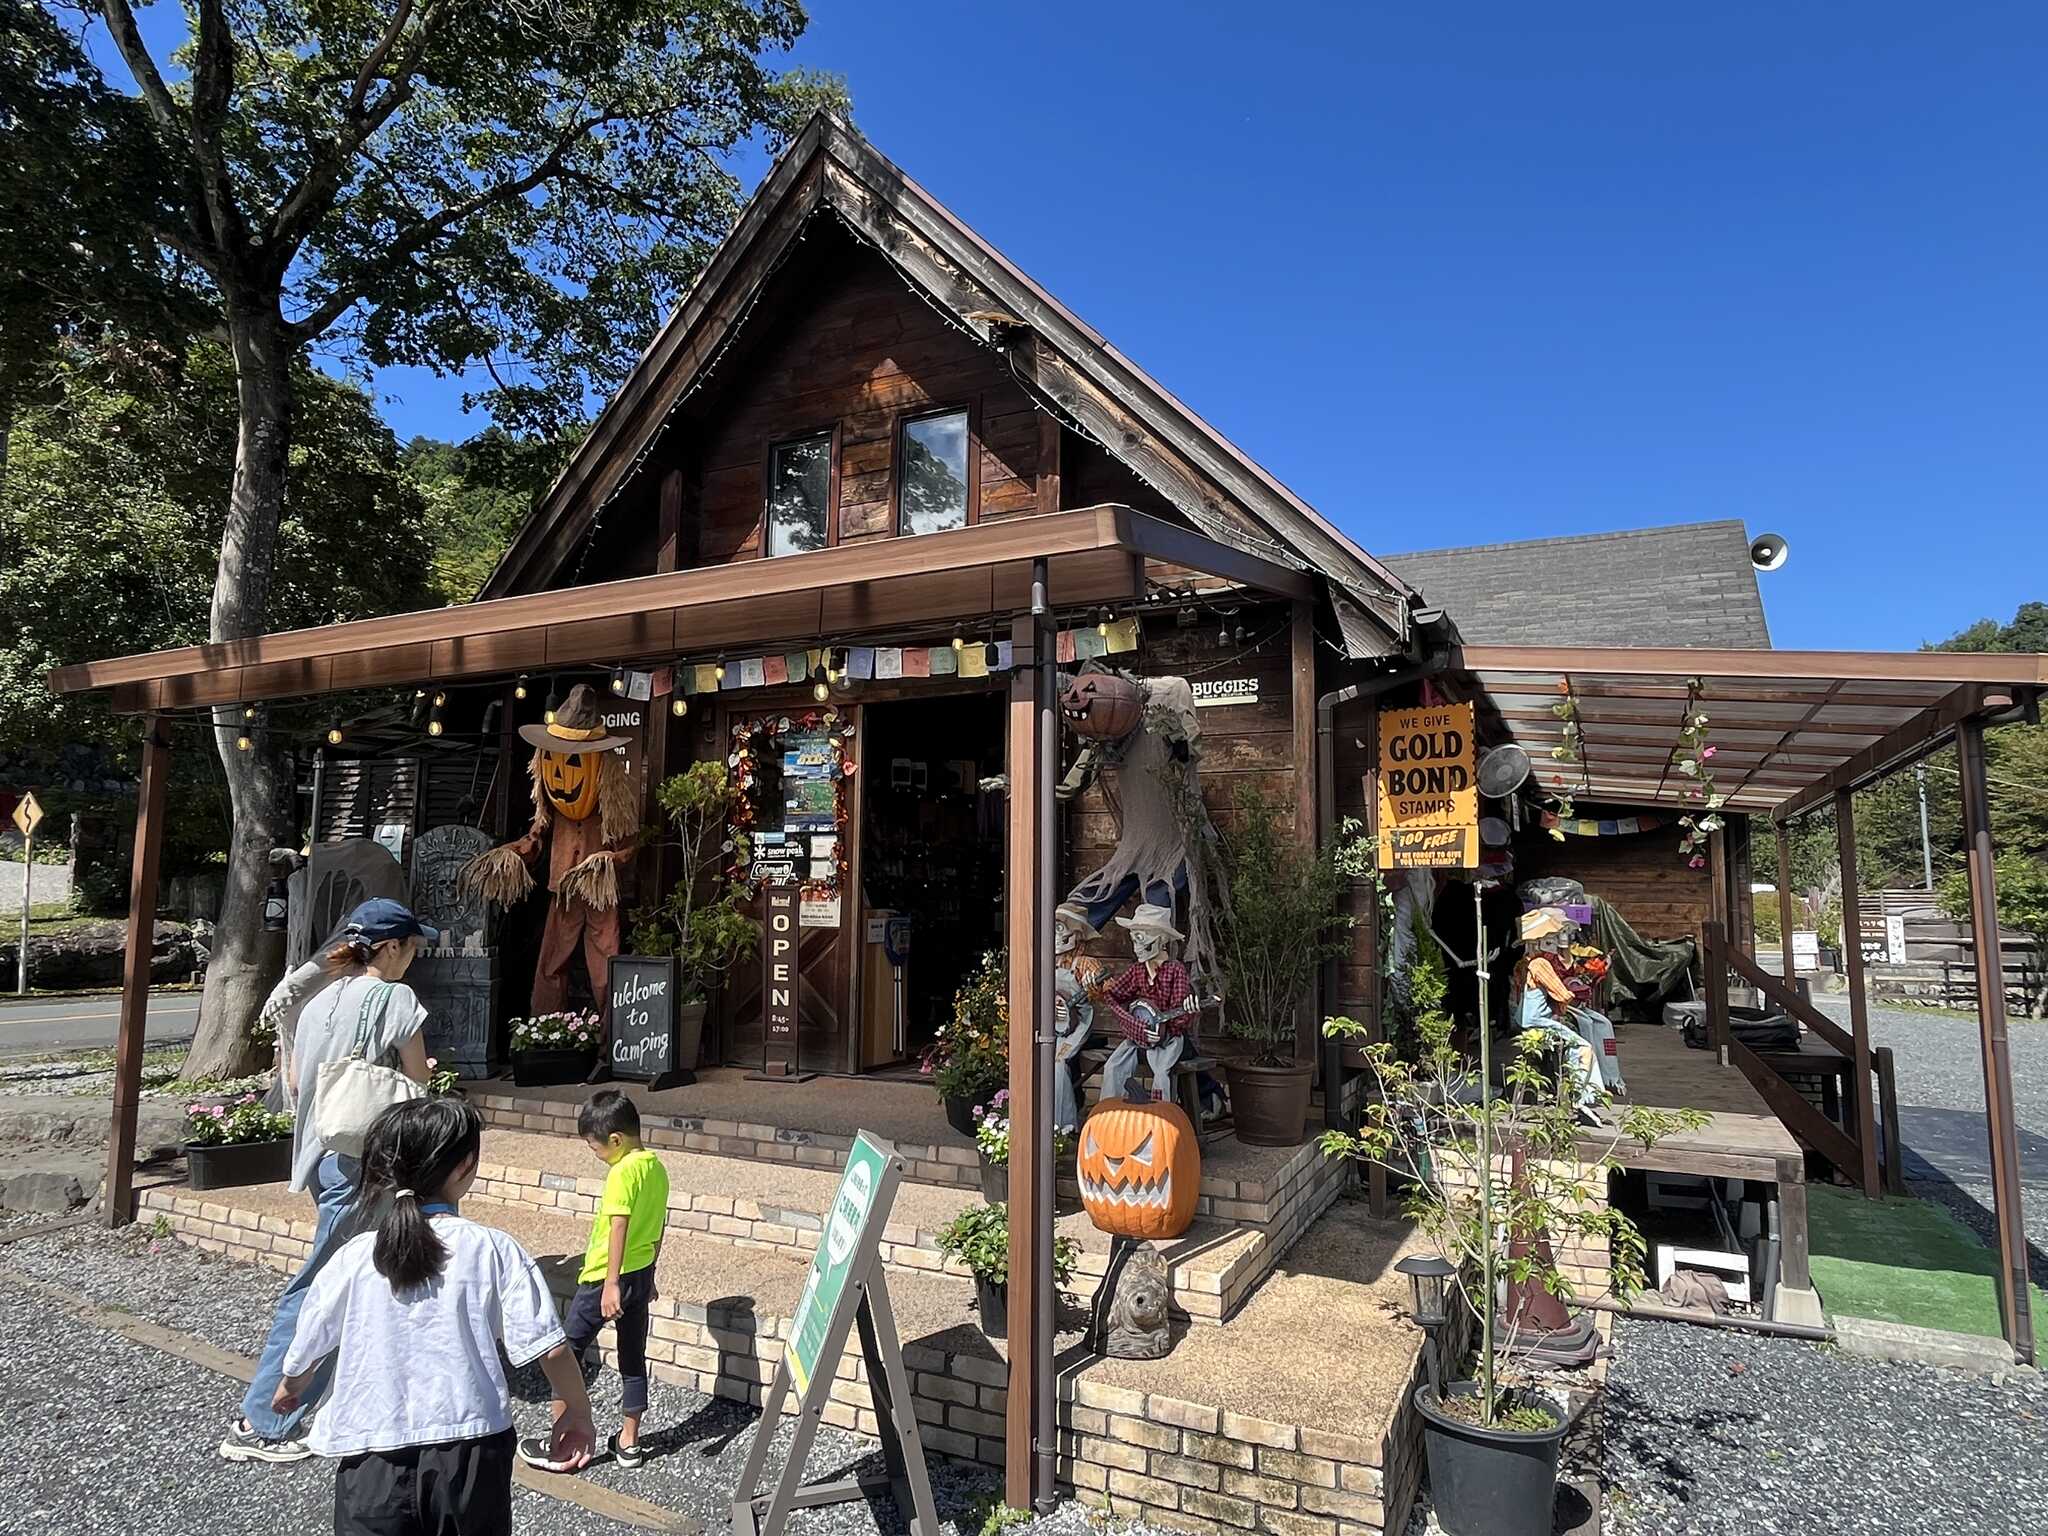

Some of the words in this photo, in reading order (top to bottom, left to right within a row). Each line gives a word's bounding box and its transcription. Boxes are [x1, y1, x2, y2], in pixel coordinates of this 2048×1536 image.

[1192, 678, 1259, 696] BUGGIES
[1400, 718, 1419, 729] WE
[1423, 715, 1450, 727] GIVE
[1389, 730, 1463, 762] GOLD
[1388, 764, 1468, 796] BOND
[1399, 799, 1456, 815] STAMPS
[1422, 829, 1459, 850] FREE
[767, 848, 786, 856] snow
[786, 844, 805, 857] peak
[772, 914, 790, 1006] OPEN
[626, 1008, 649, 1026] to
[612, 1031, 669, 1066] Camping
